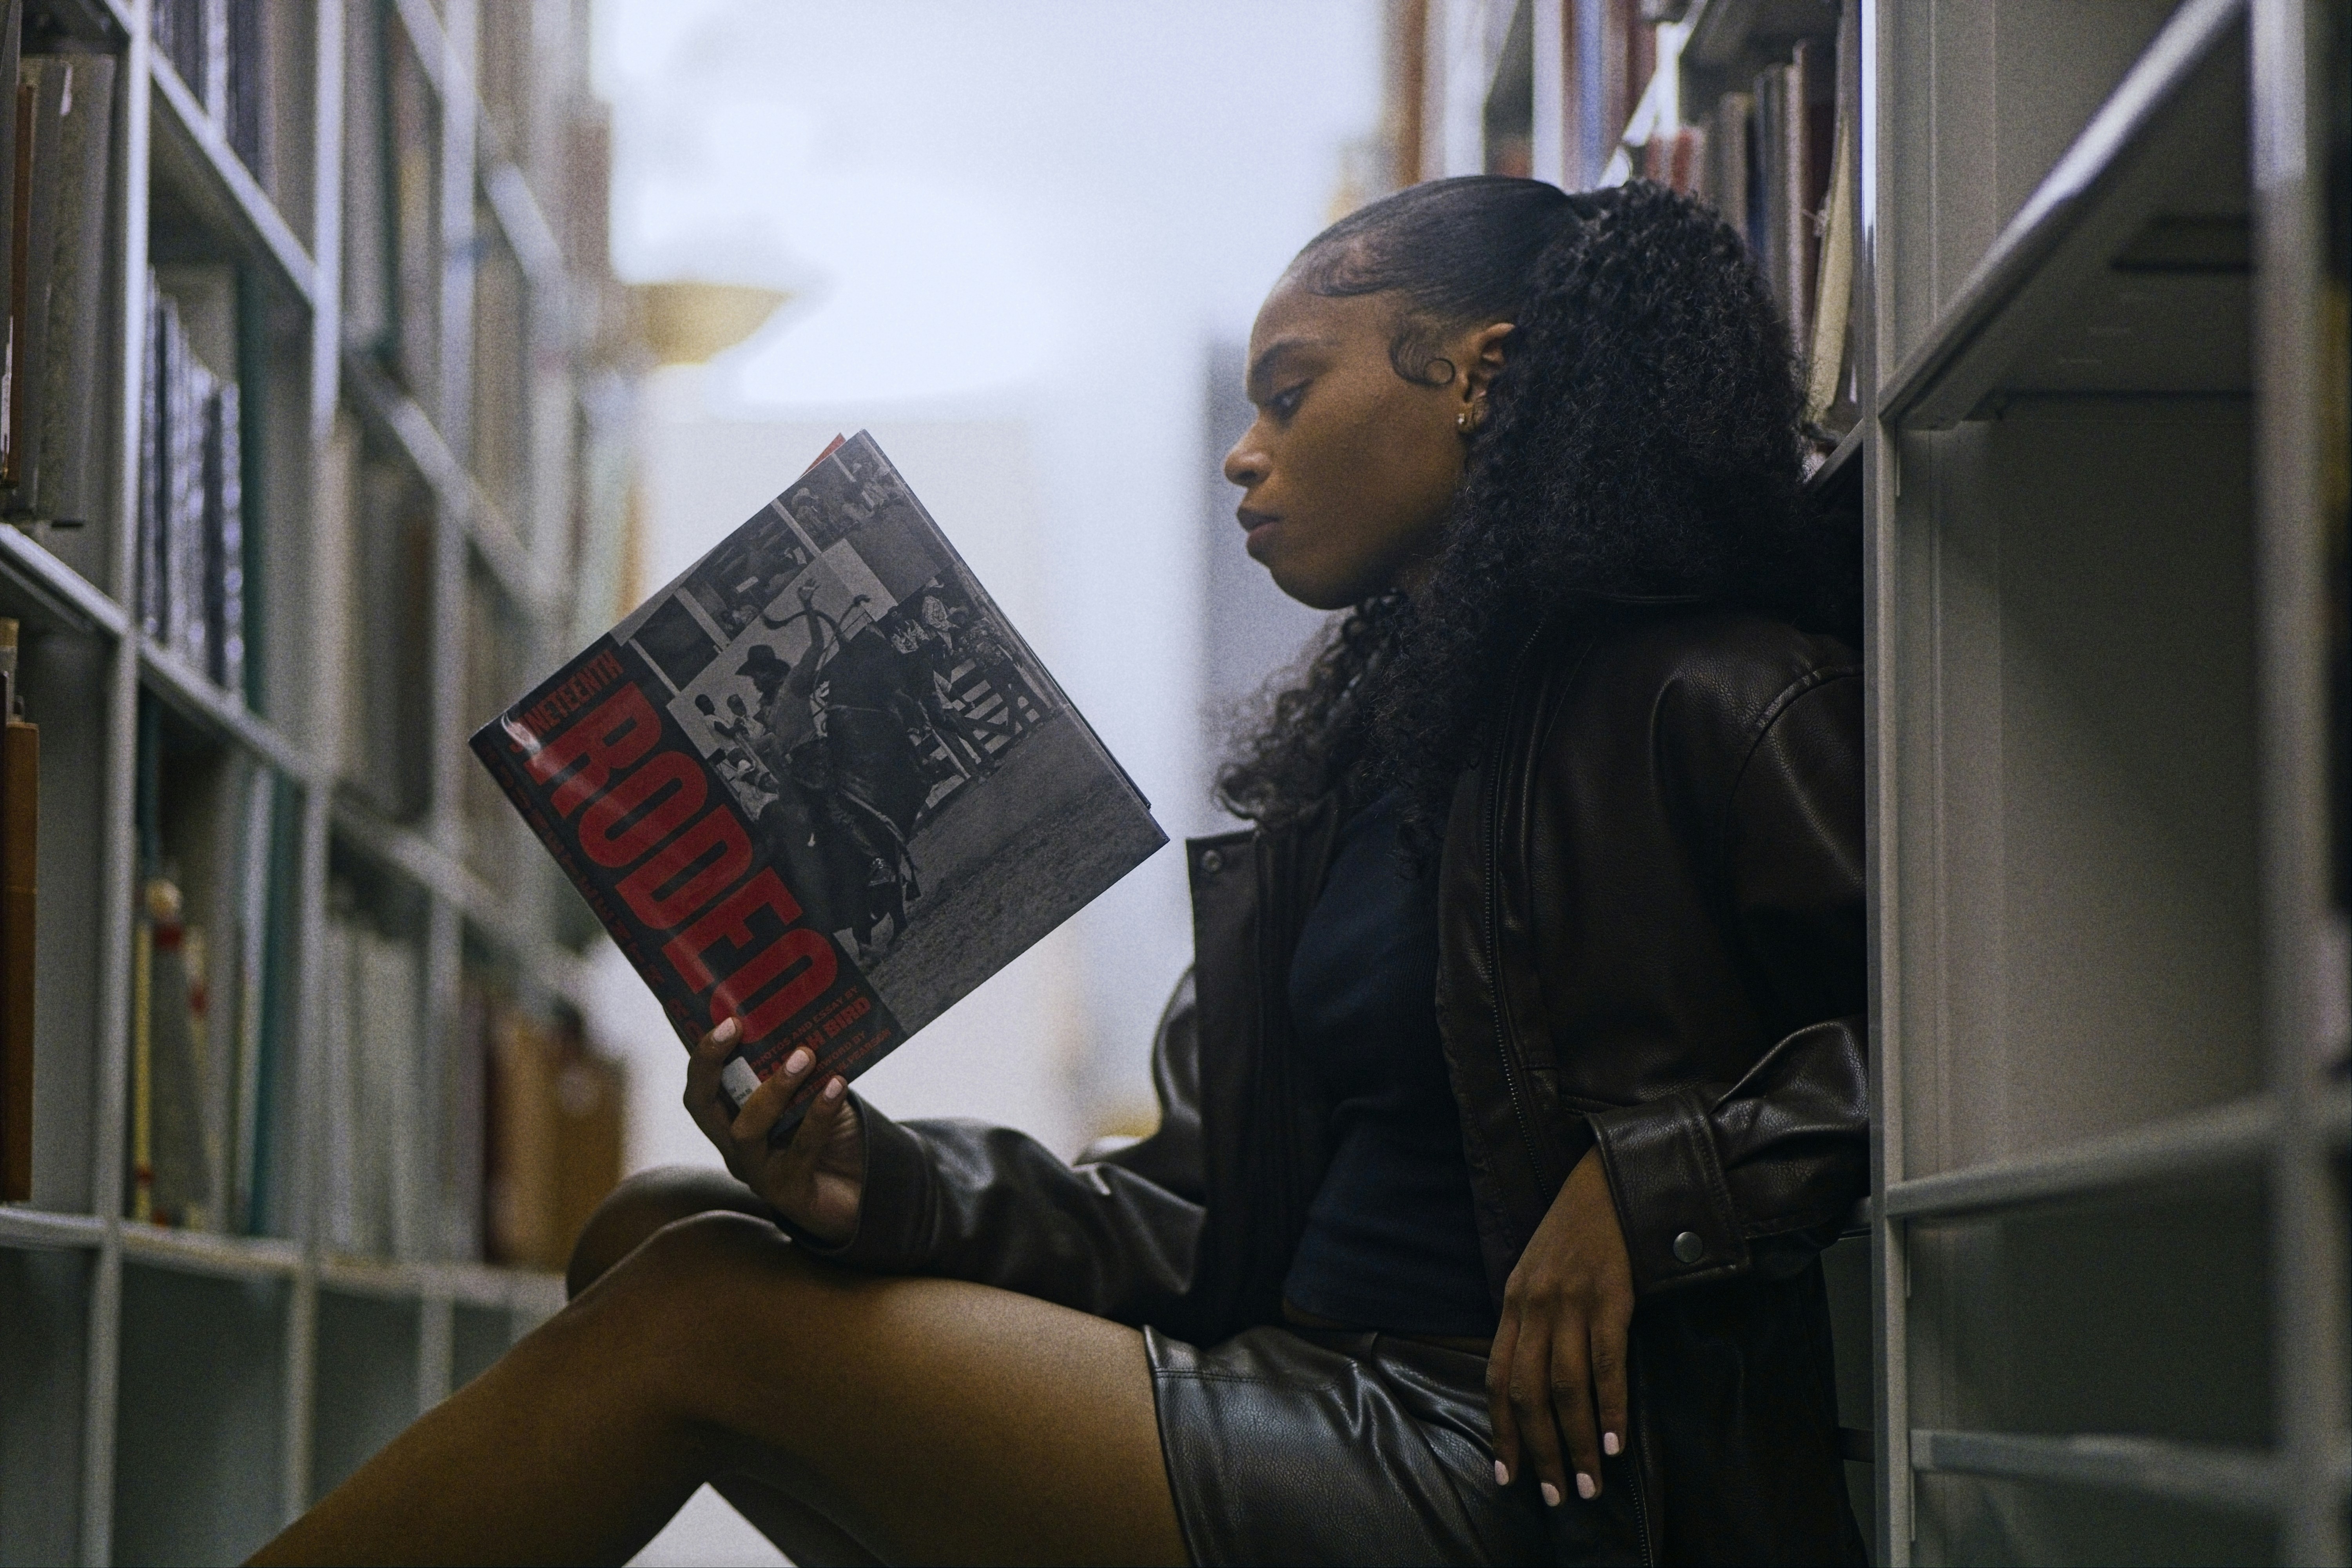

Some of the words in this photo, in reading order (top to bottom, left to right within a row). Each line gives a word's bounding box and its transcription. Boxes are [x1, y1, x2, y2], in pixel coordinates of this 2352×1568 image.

[523, 681, 838, 1044] RODEO
[748, 1037, 791, 1069] PHOTOS
[793, 1021, 813, 1040] AND
[813, 996, 843, 1023] ESSAY
[844, 985, 858, 999] BY
[757, 1030, 826, 1082] SAH
[823, 997, 871, 1038] BIRD
[847, 1029, 892, 1064] PEARSON
[852, 1030, 865, 1045] BY
